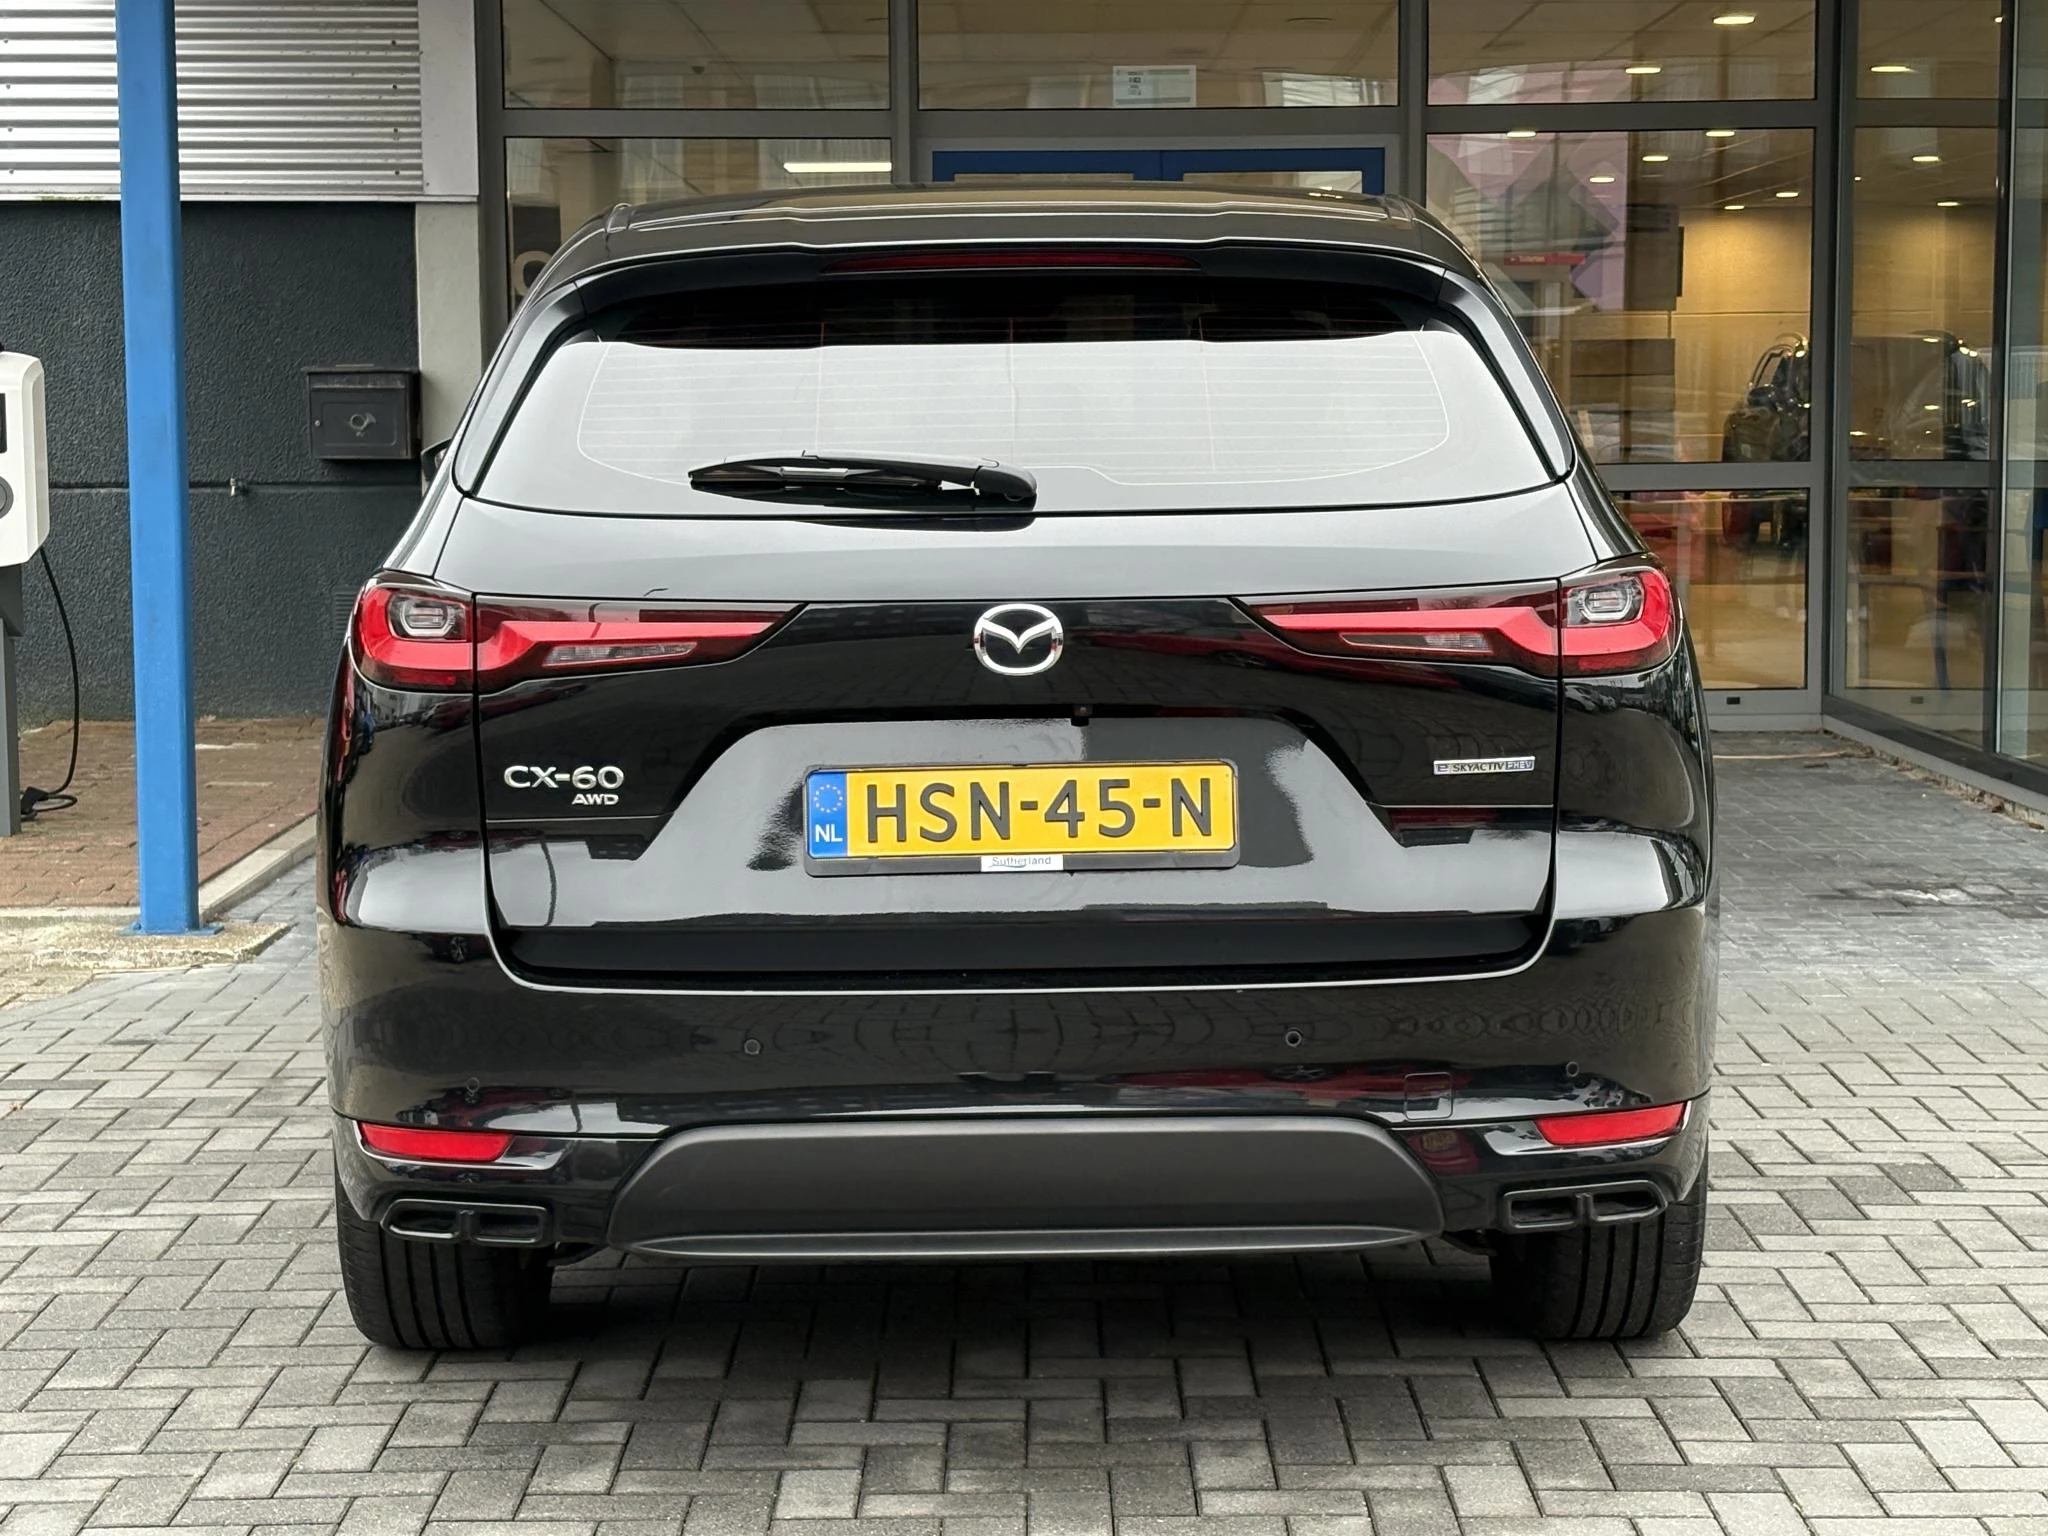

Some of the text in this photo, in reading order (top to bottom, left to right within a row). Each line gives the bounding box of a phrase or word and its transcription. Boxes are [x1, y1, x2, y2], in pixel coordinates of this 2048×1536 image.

[1452, 762, 1505, 773] SKYACTIV
[504, 765, 625, 789] CX-60
[571, 793, 619, 806] AWD
[866, 777, 1212, 843] HSN-45-N
[815, 823, 843, 843] NL
[992, 856, 1052, 866] Sutherland
